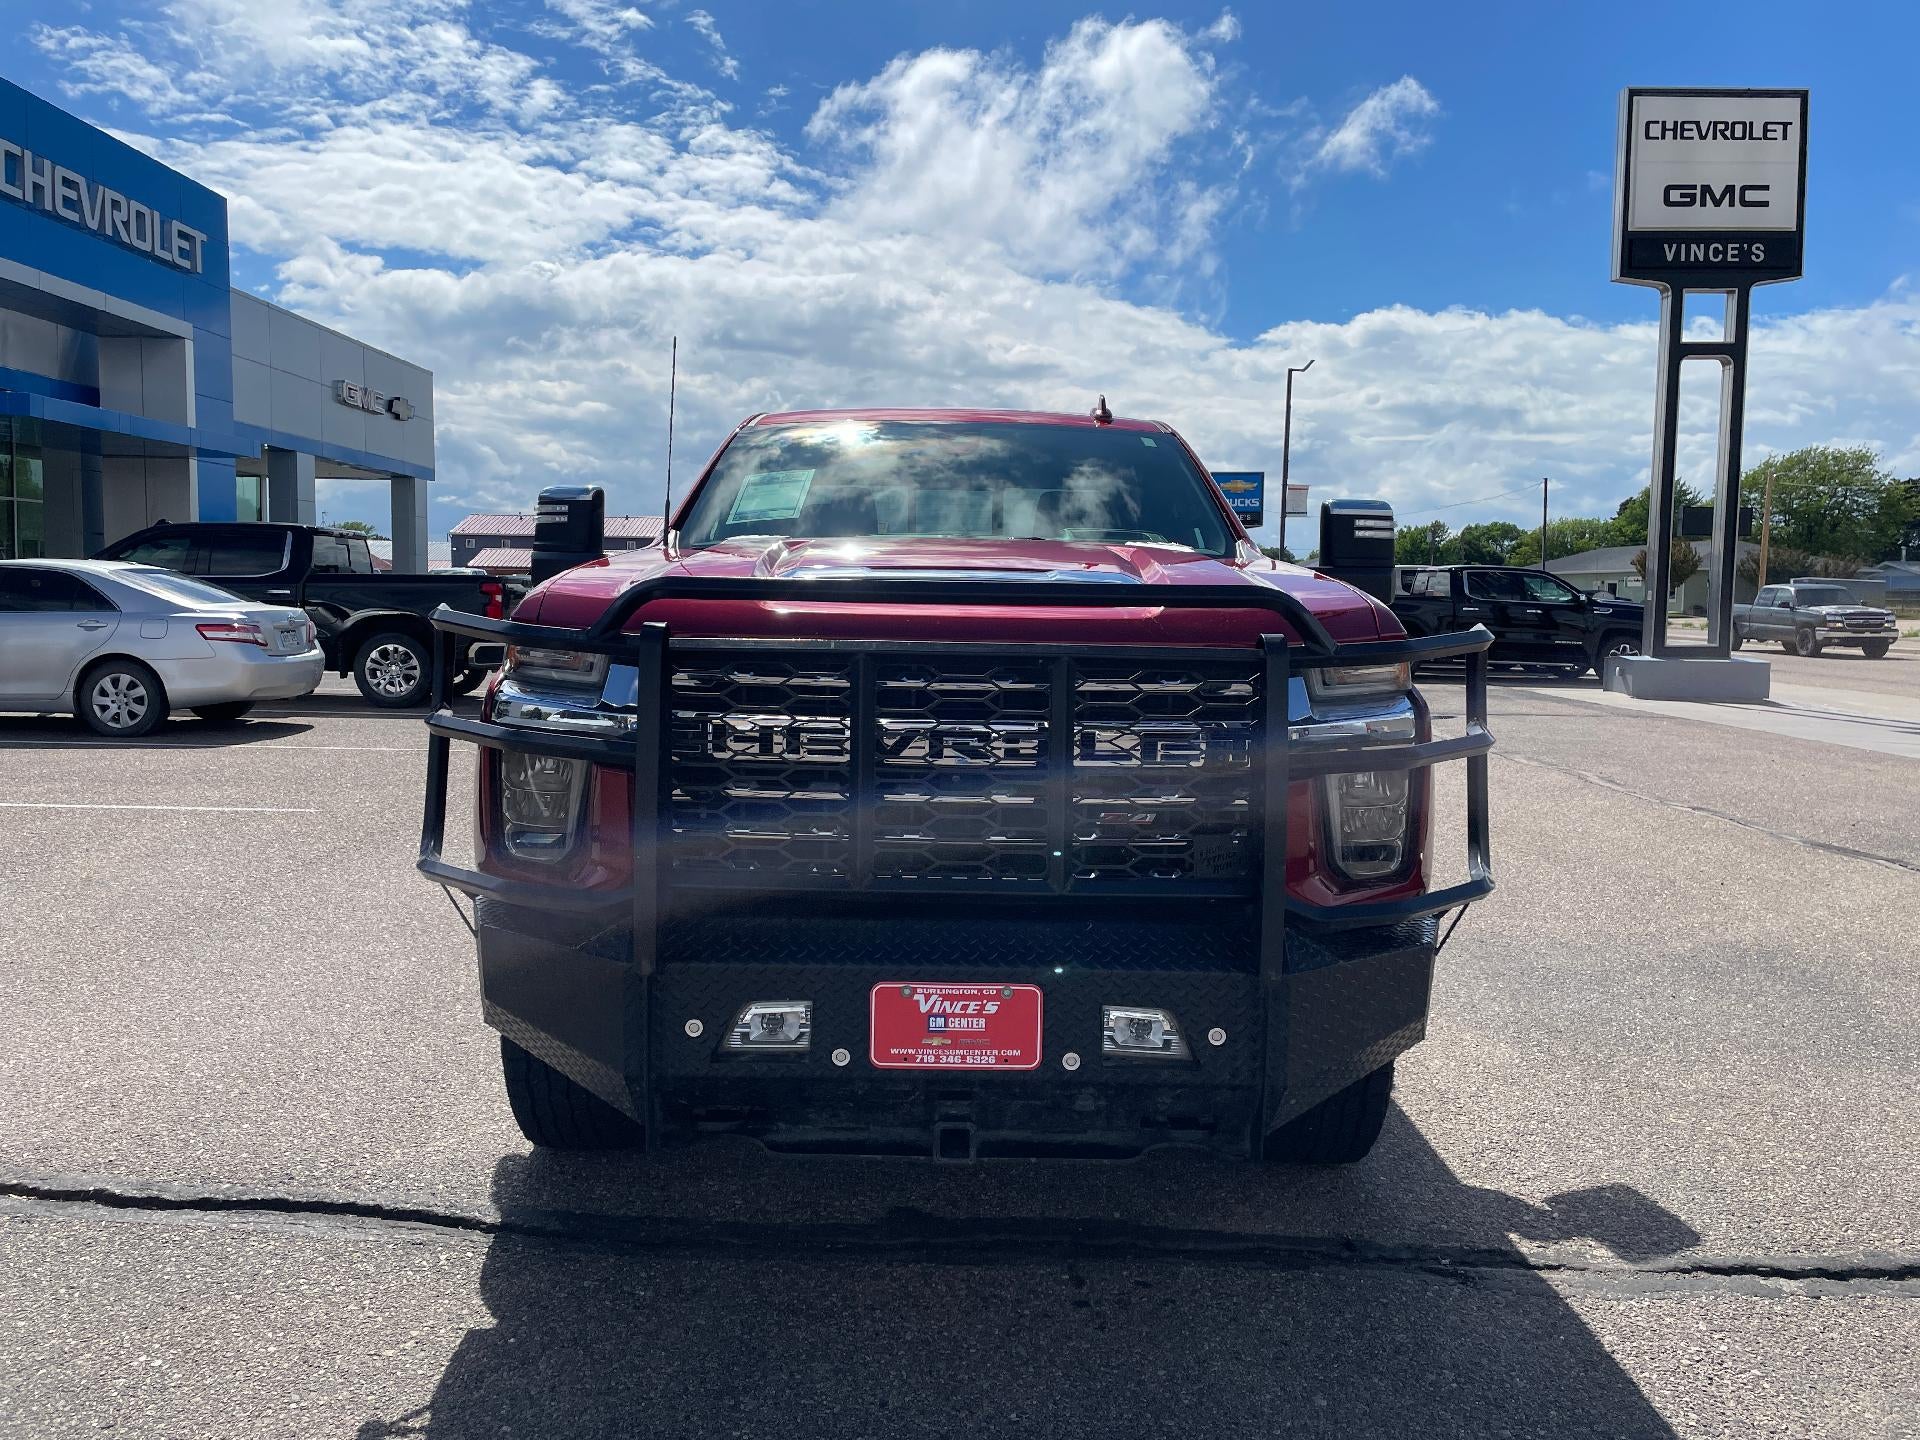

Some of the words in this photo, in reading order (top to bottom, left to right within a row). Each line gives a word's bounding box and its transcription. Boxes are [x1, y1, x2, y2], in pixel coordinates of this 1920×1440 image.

[1644, 120, 1793, 141] CHEVROLET
[0, 138, 208, 274] CHEVROLET
[1663, 184, 1770, 208] GMC
[1663, 243, 1766, 262] VINCE'S
[342, 380, 386, 416] GMC
[929, 1017, 945, 1028] GM
[948, 1017, 986, 1029] CENTER
